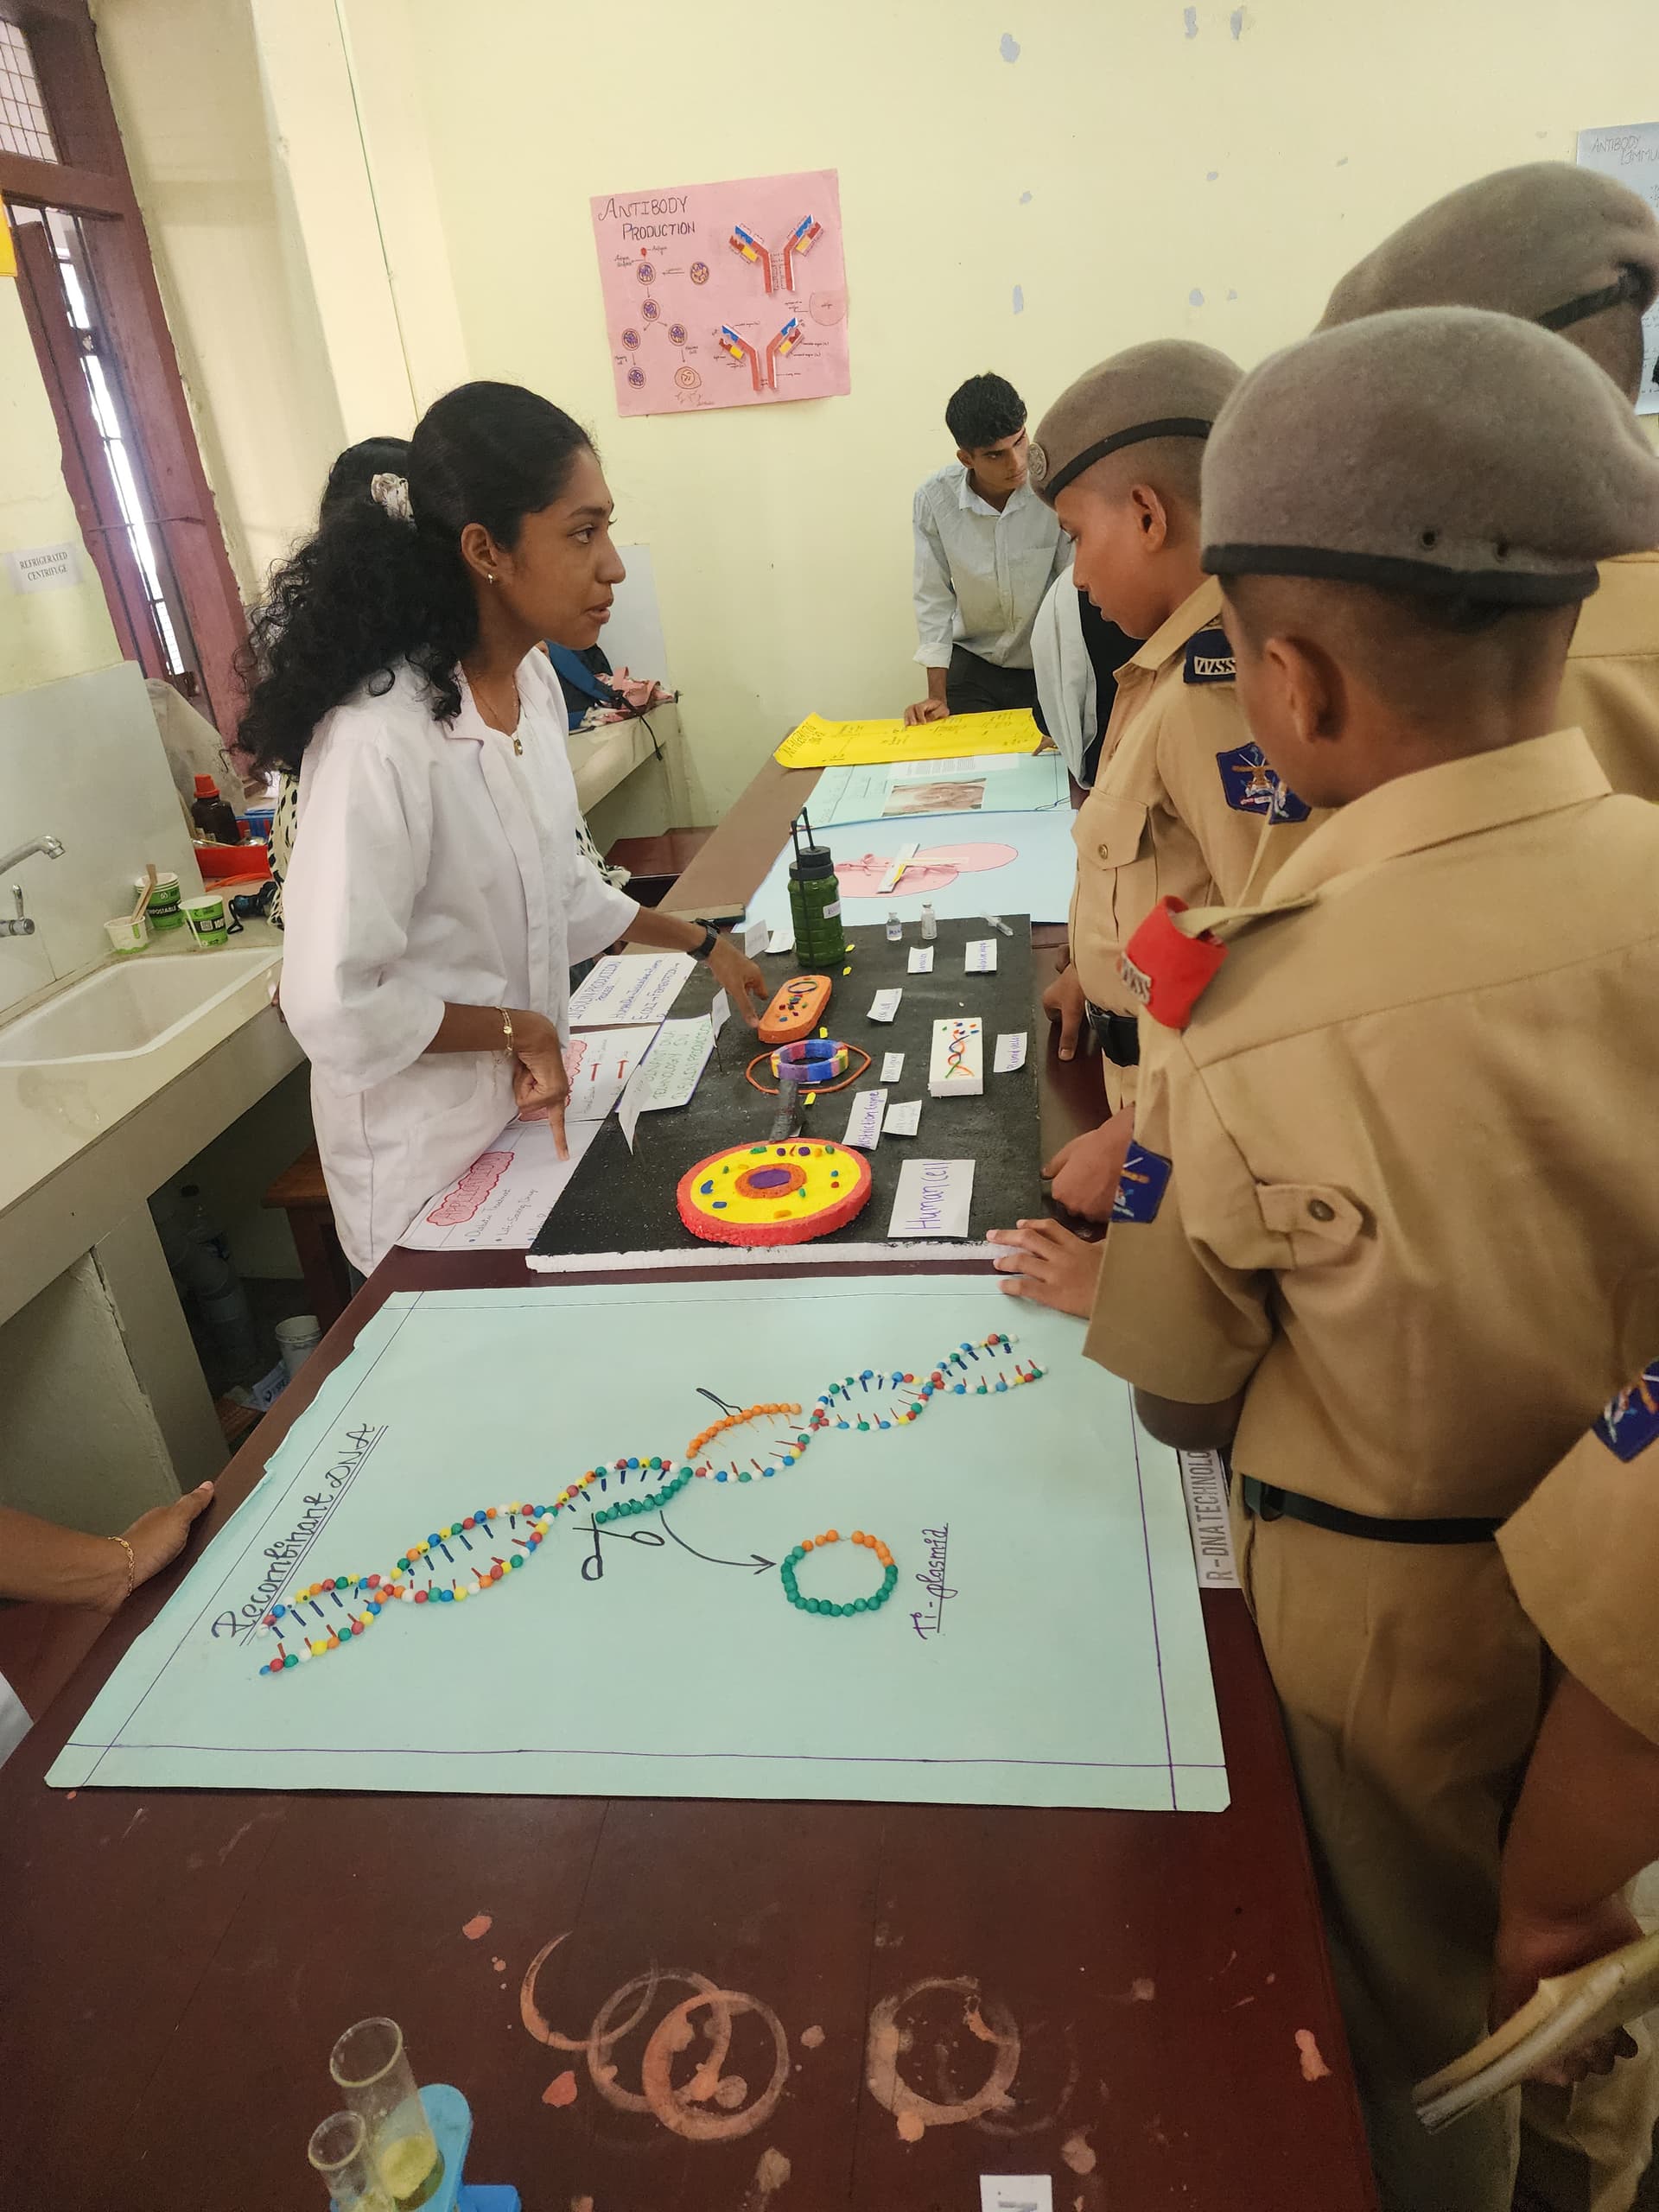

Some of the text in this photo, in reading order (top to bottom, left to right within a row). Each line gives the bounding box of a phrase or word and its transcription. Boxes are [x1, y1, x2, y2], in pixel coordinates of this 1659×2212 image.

[598, 195, 689, 220] ANTIBODY
[622, 221, 696, 241] PRODUCTION
[19, 551, 68, 570] REFRIGERATED
[27, 564, 67, 582] CENTRIFUGE
[905, 1161, 953, 1231] Human Cell
[211, 1422, 376, 1639] Recombinant DNA
[1199, 1524, 1235, 1581] R-DNA
